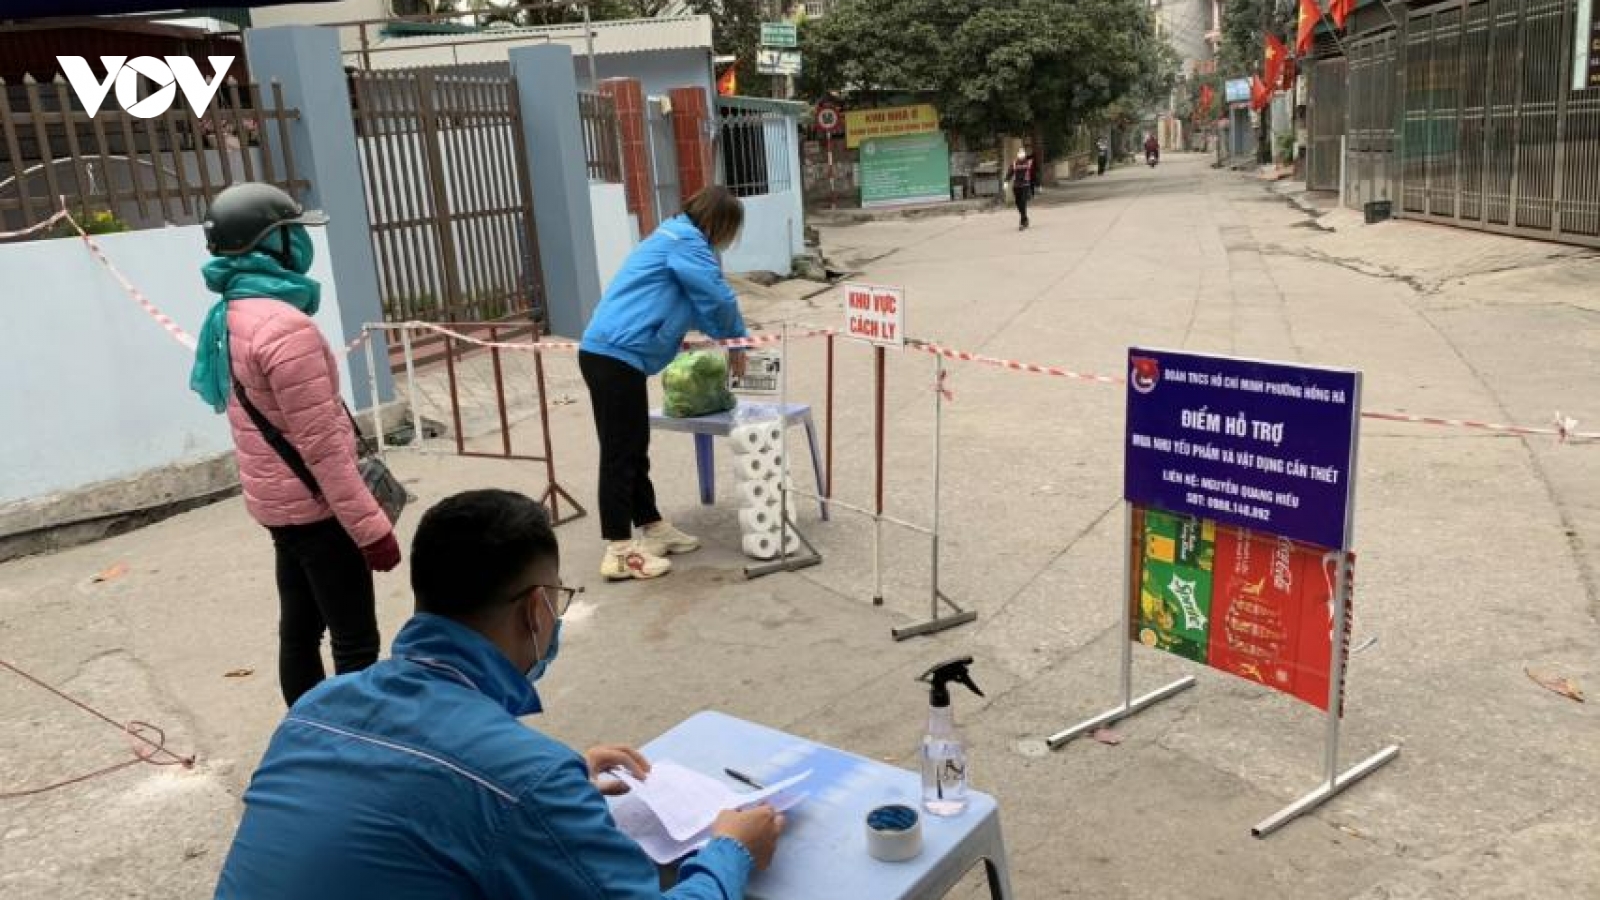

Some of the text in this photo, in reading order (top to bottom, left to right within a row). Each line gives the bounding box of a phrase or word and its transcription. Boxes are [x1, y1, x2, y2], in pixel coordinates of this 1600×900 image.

[849, 291, 897, 316] KHU VỰC
[850, 314, 897, 340] CÁCH LY
[1164, 367, 1187, 382] ĐOÀN
[1187, 372, 1209, 385] TNCS
[1240, 379, 1263, 393] MINH
[1182, 405, 1221, 433] ĐIỂM
[1251, 420, 1284, 446] TRỢ
[1132, 434, 1151, 448] MUA
[1222, 448, 1234, 464] VÀ
[1236, 450, 1255, 469] VẬT
[1256, 456, 1285, 473] DỤNG
[1310, 465, 1339, 484] THIẾT
[1240, 485, 1273, 503] QUANG
